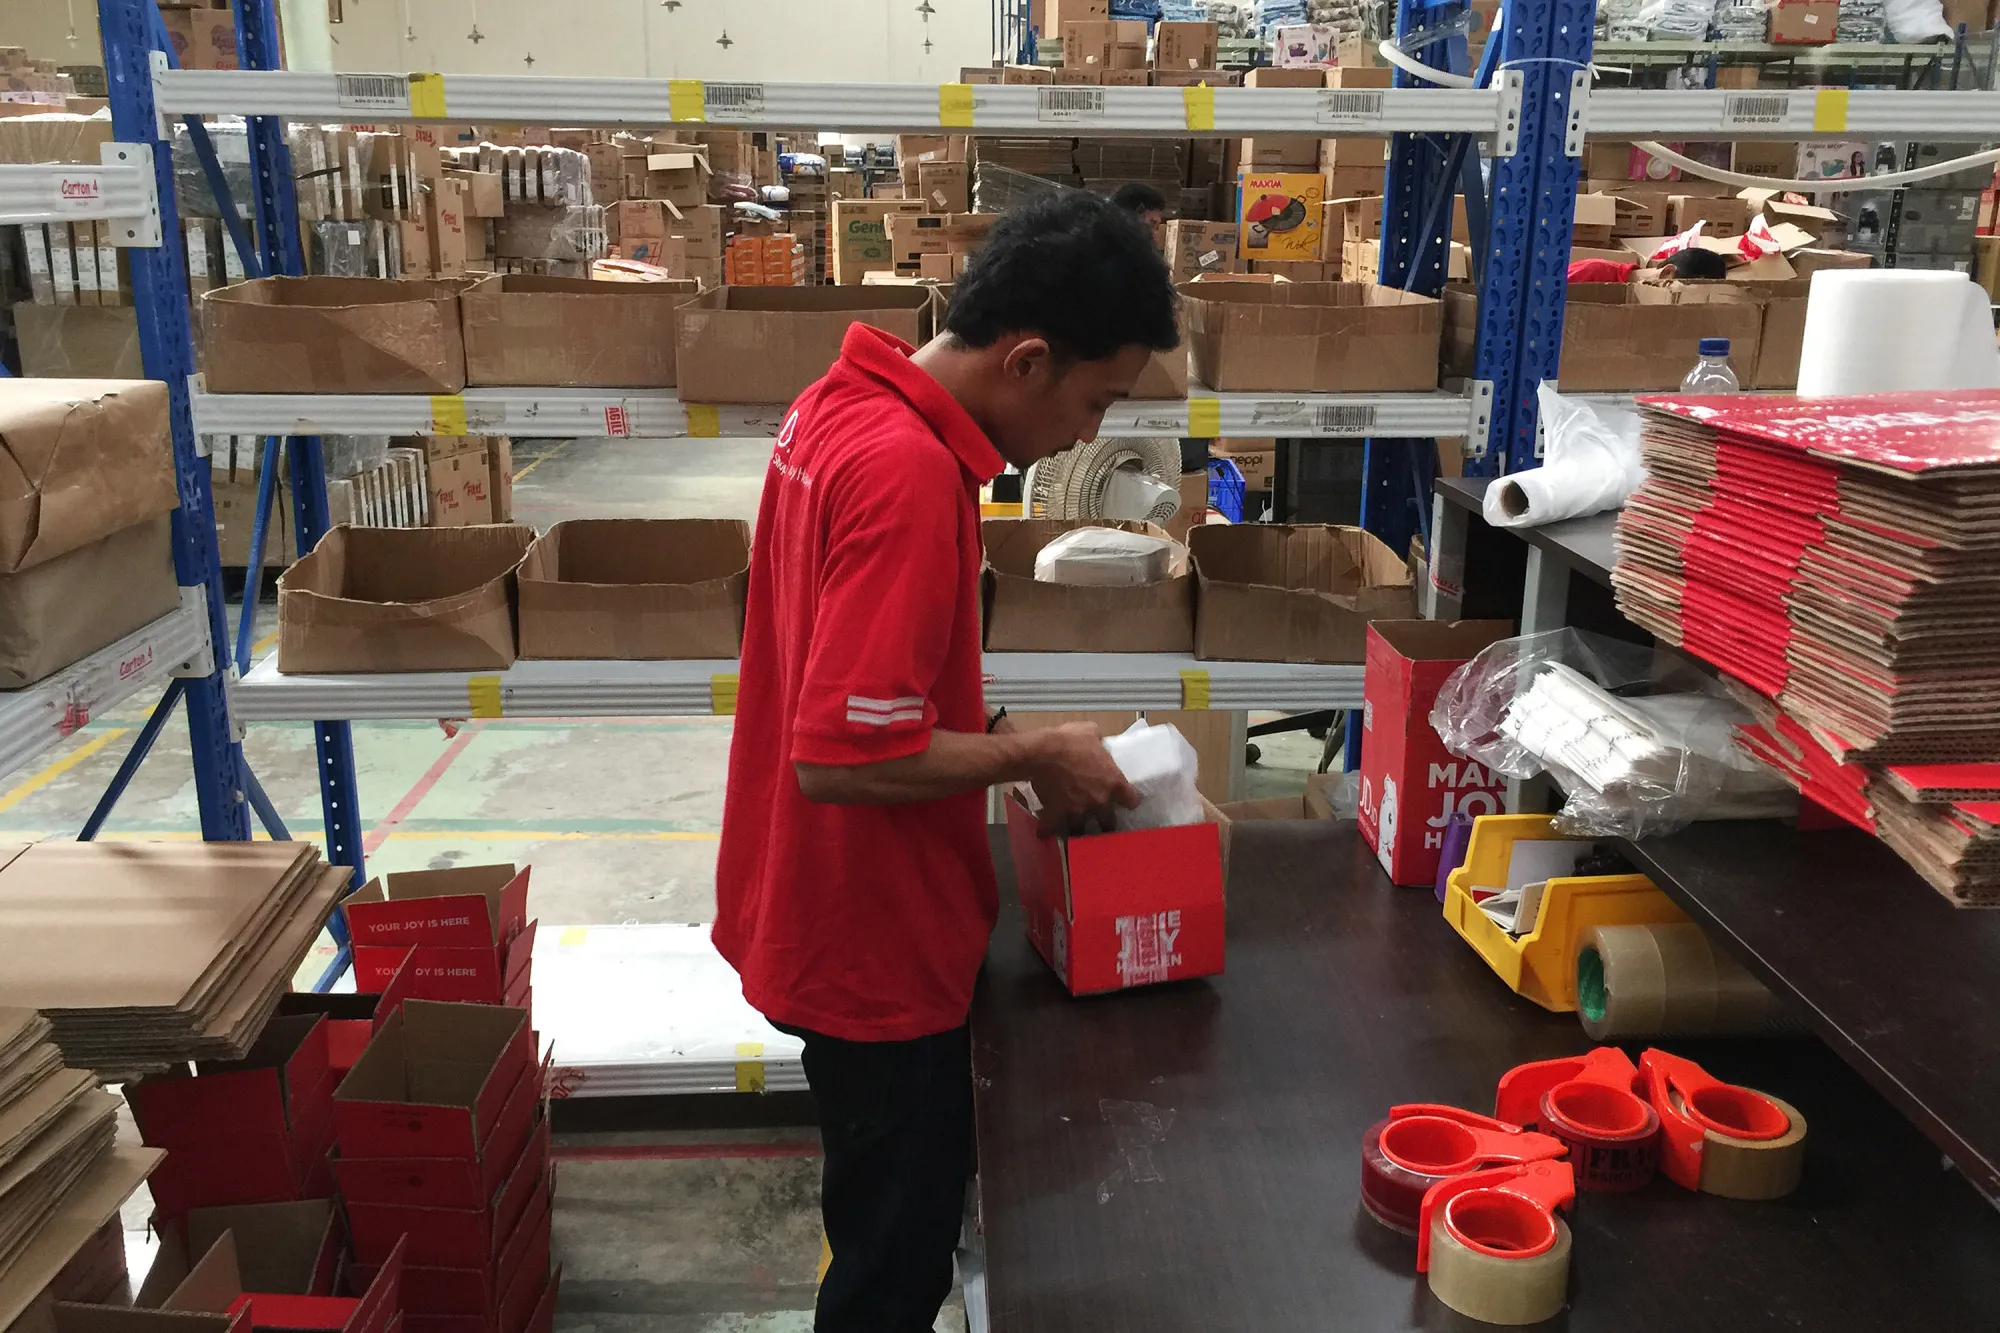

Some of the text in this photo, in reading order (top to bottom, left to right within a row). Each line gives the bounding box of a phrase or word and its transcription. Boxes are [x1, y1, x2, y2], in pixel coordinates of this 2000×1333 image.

[61, 178, 91, 195] Carton
[1250, 179, 1282, 188] MAXIM
[119, 653, 146, 676] Carton
[1428, 762, 1508, 788] MAK
[368, 916, 471, 933] YOUR JOY IS HERE
[375, 967, 477, 977] YOU OY IS HERE
